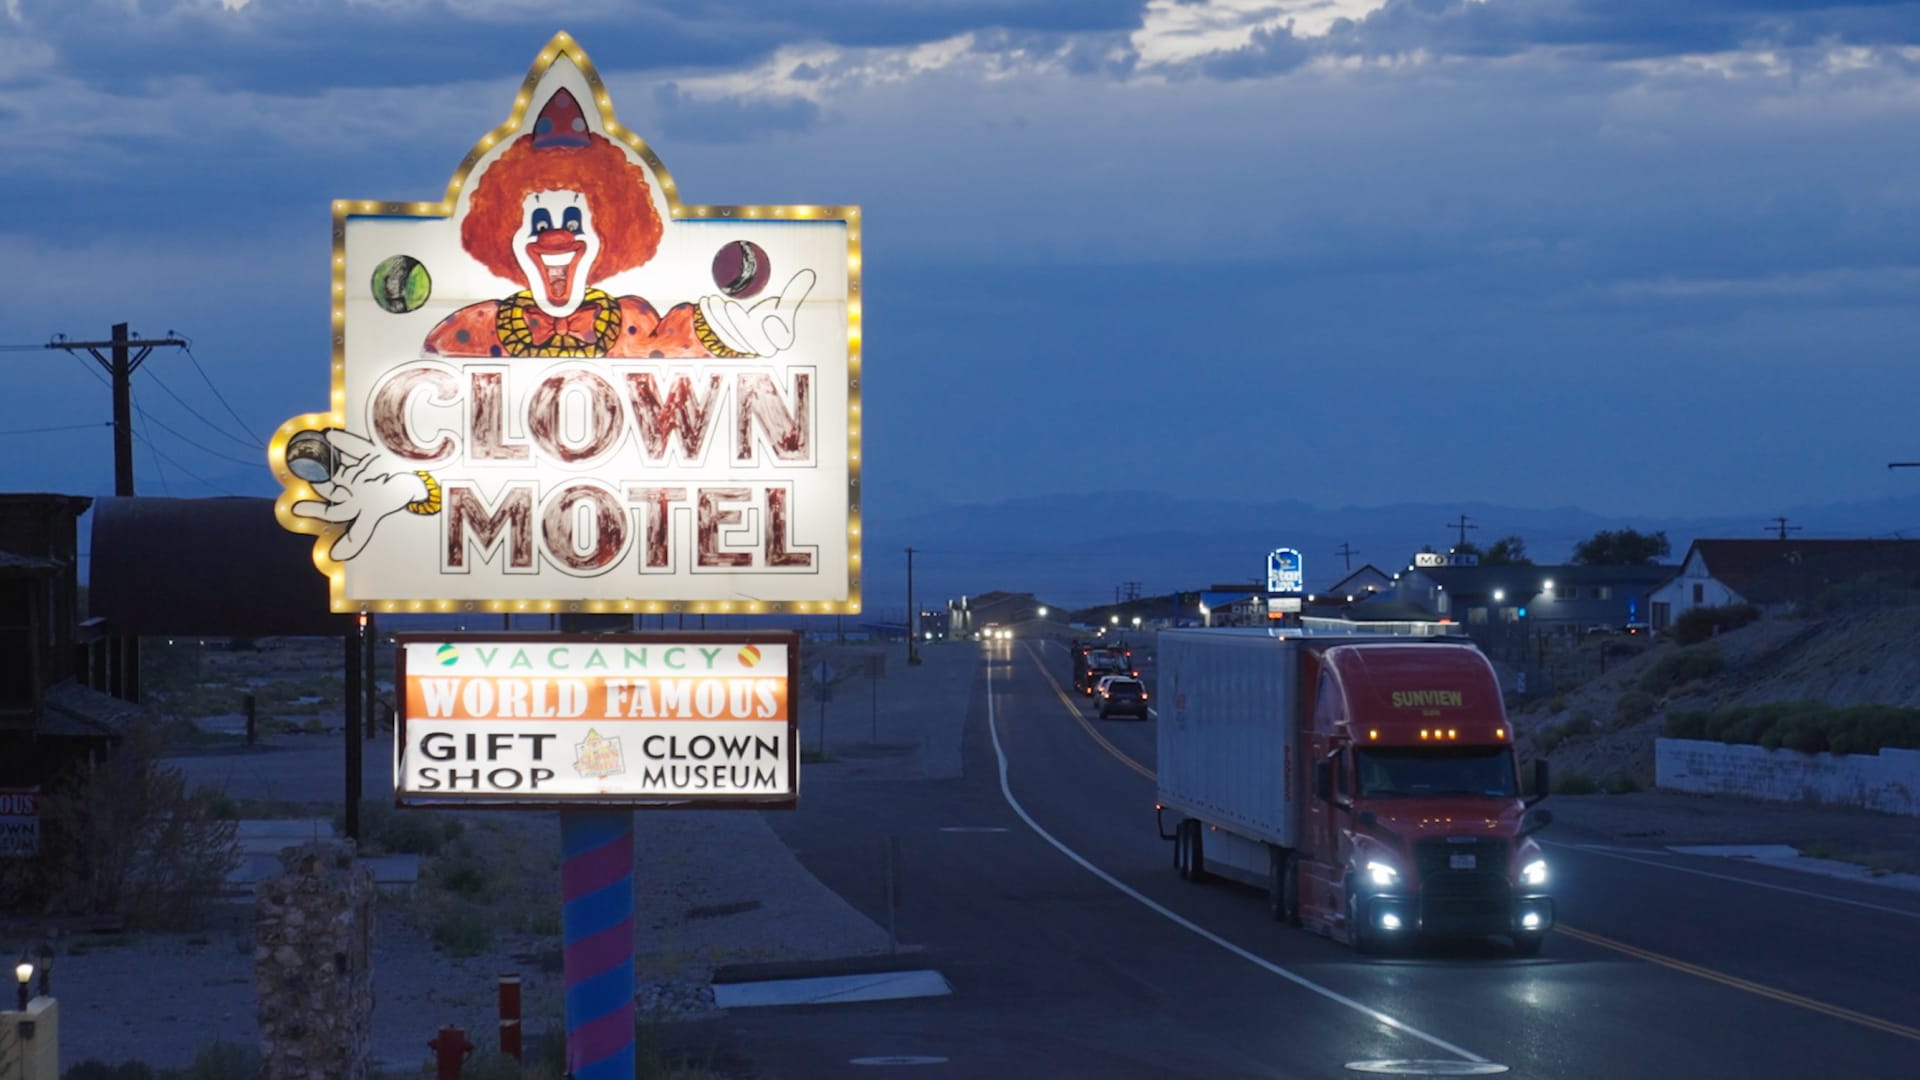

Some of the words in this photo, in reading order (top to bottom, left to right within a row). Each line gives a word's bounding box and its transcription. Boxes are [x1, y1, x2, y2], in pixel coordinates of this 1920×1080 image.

[373, 367, 811, 462] CLOWN
[446, 484, 812, 570] MOTEL
[1420, 555, 1475, 566] MOTEL
[475, 647, 723, 670] VACANCY
[419, 678, 588, 718] WORLD
[604, 676, 778, 718] FAMOUS
[1391, 690, 1462, 707] SUNVIEW
[419, 732, 556, 761] GIFT
[642, 735, 780, 760] CLOWN
[417, 767, 555, 790] SHOP
[641, 765, 777, 789] MUSEUM
